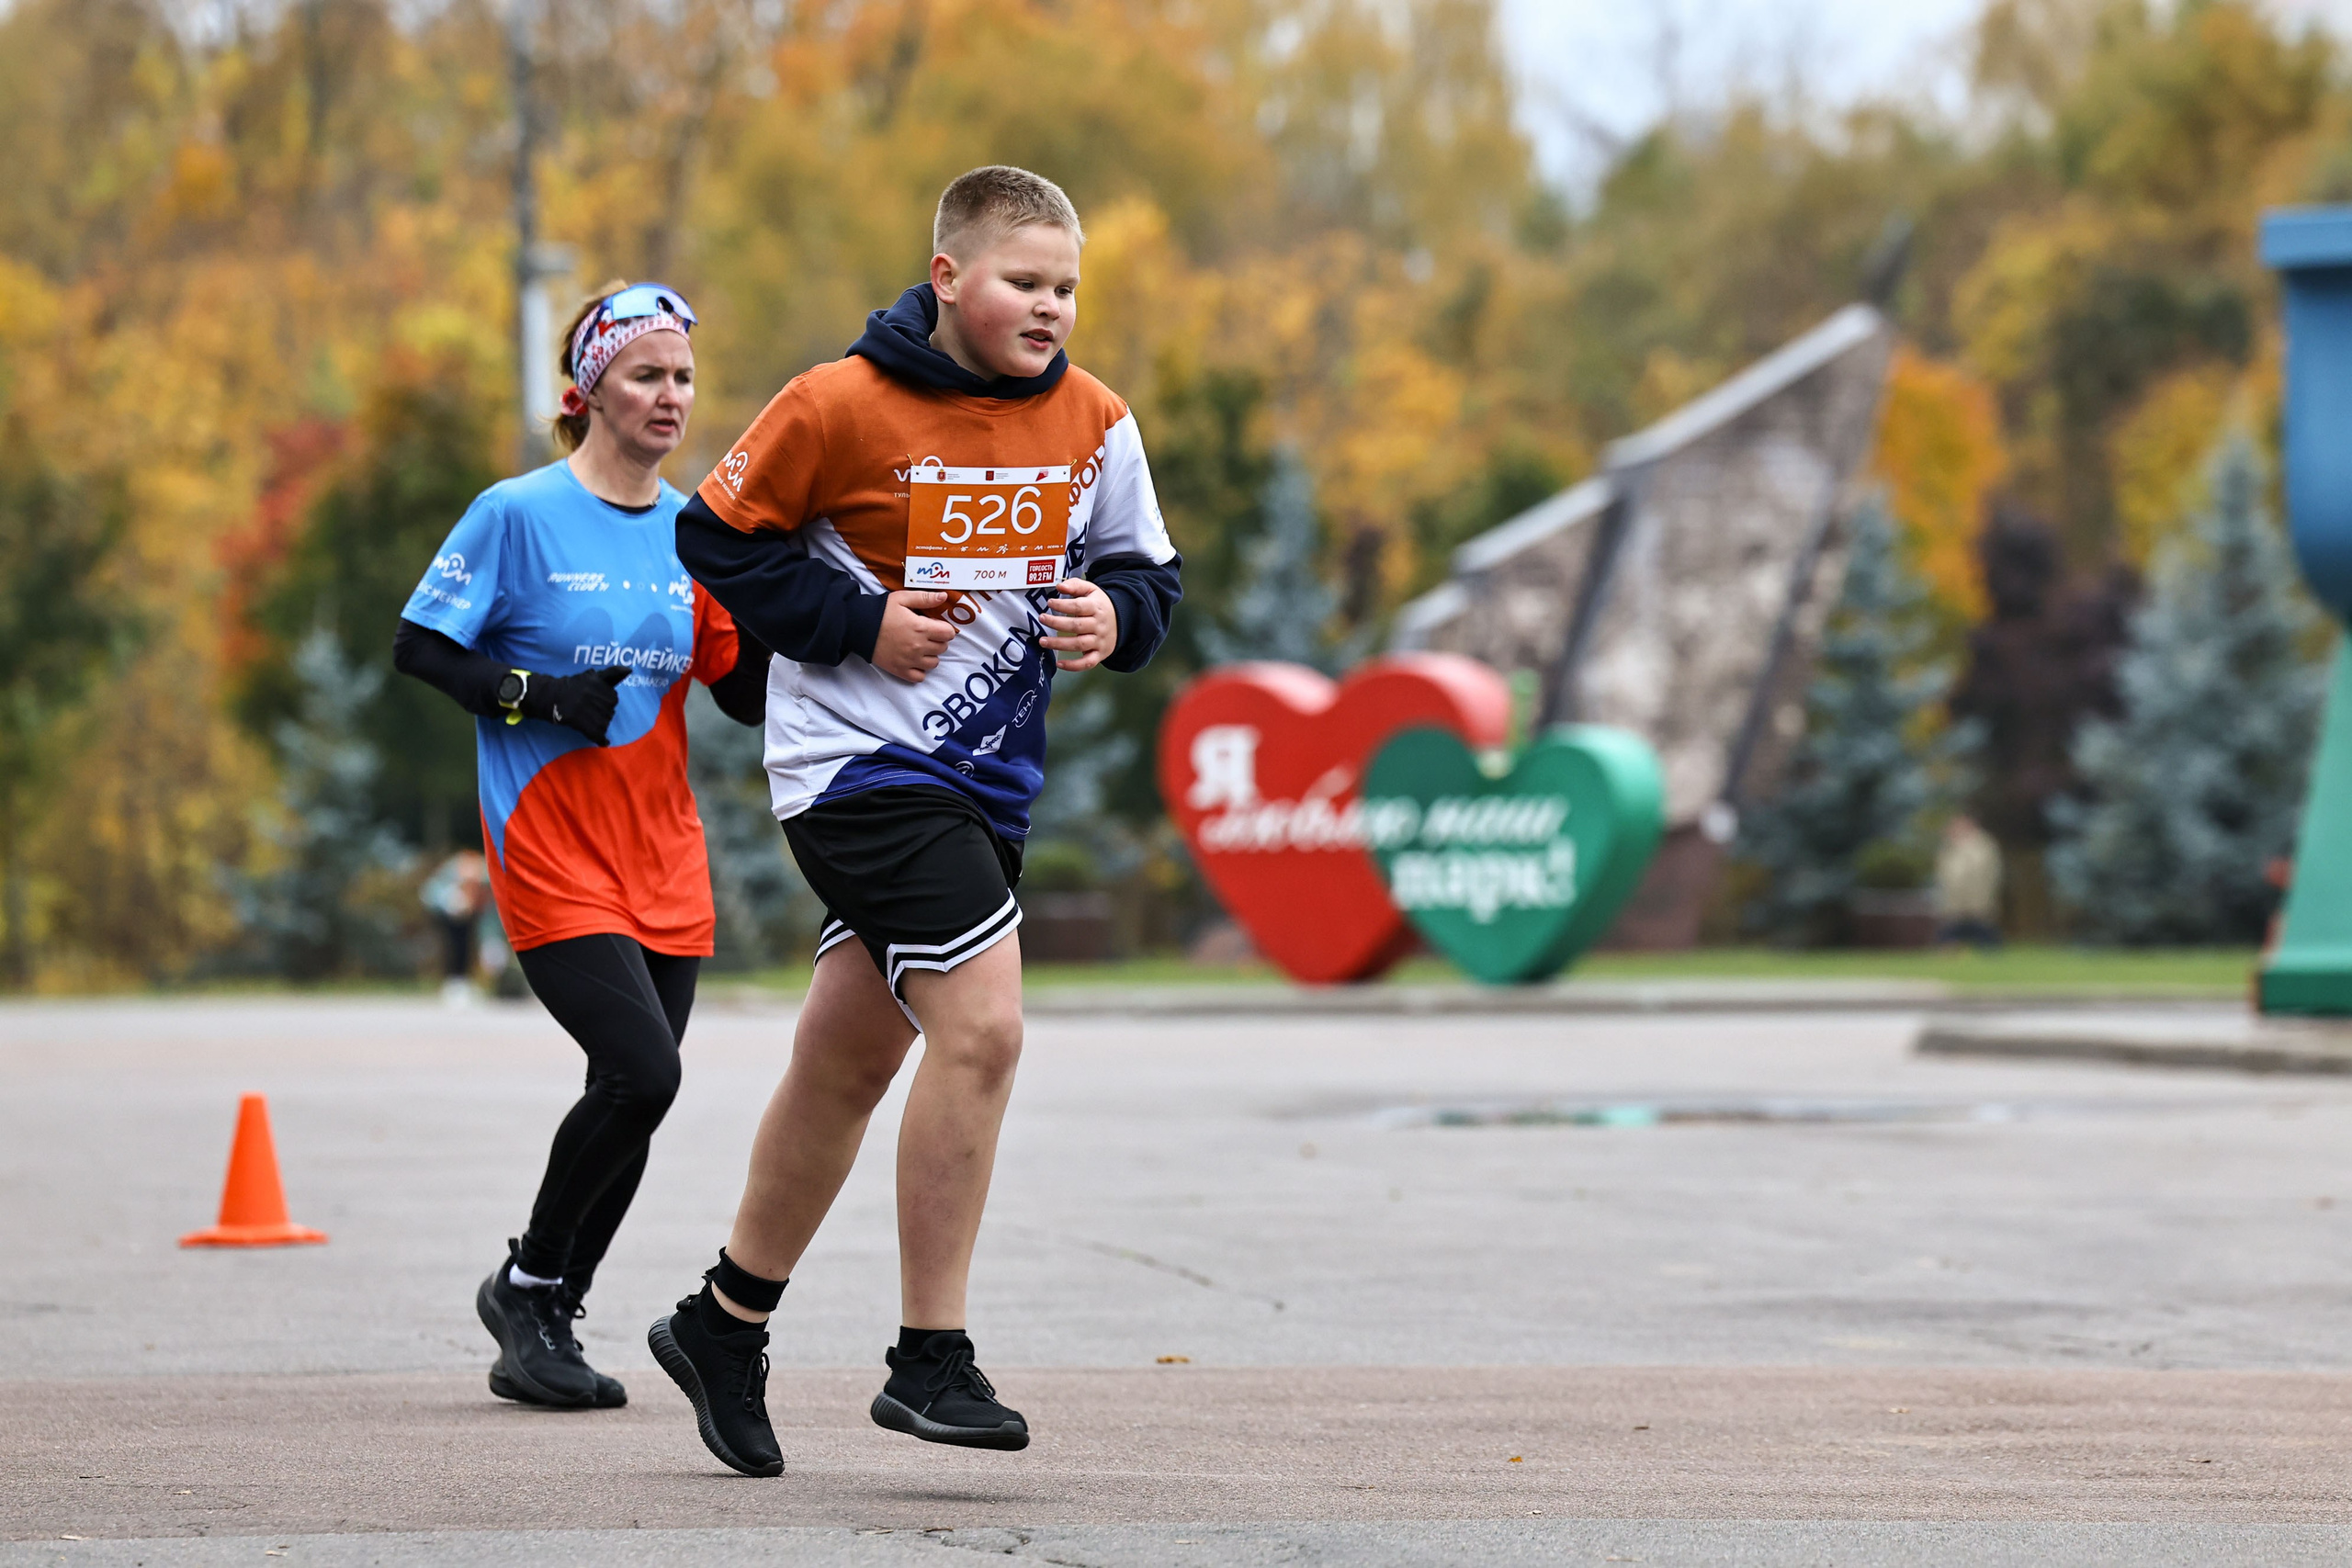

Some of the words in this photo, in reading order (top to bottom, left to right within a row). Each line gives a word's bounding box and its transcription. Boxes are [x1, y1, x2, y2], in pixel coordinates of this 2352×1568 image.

[939, 486, 1043, 544] 526
[974, 570, 995, 580] 700
[1028, 572, 1043, 581] 89.2
[1043, 571, 1053, 581] FM
[1188, 724, 1260, 811] Я
